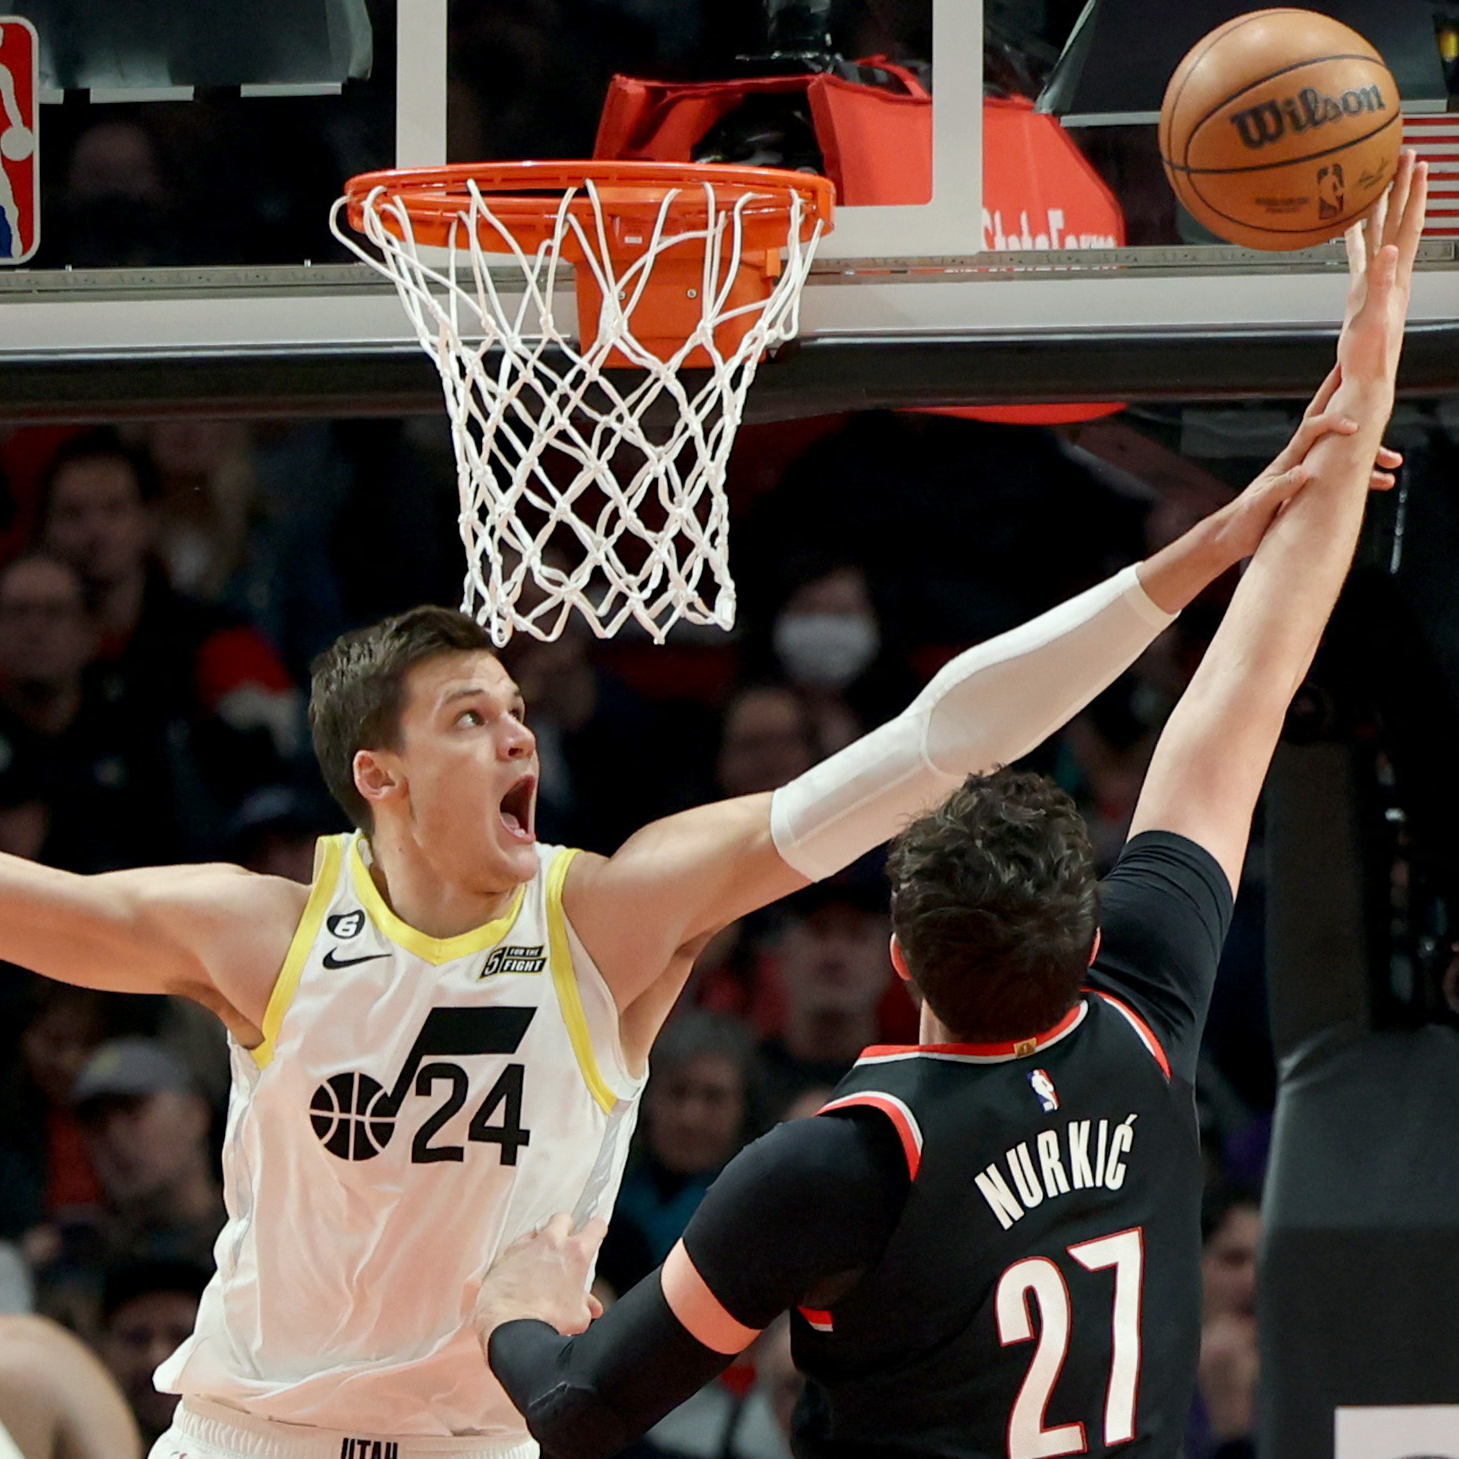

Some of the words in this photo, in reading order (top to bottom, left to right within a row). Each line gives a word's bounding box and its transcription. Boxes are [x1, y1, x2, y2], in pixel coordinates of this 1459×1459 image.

[1229, 83, 1386, 149] Wilson
[484, 950, 503, 976] 5
[503, 960, 543, 971] FIGHT
[411, 1062, 530, 1166] 24
[974, 1113, 1138, 1230] NURKIĆ
